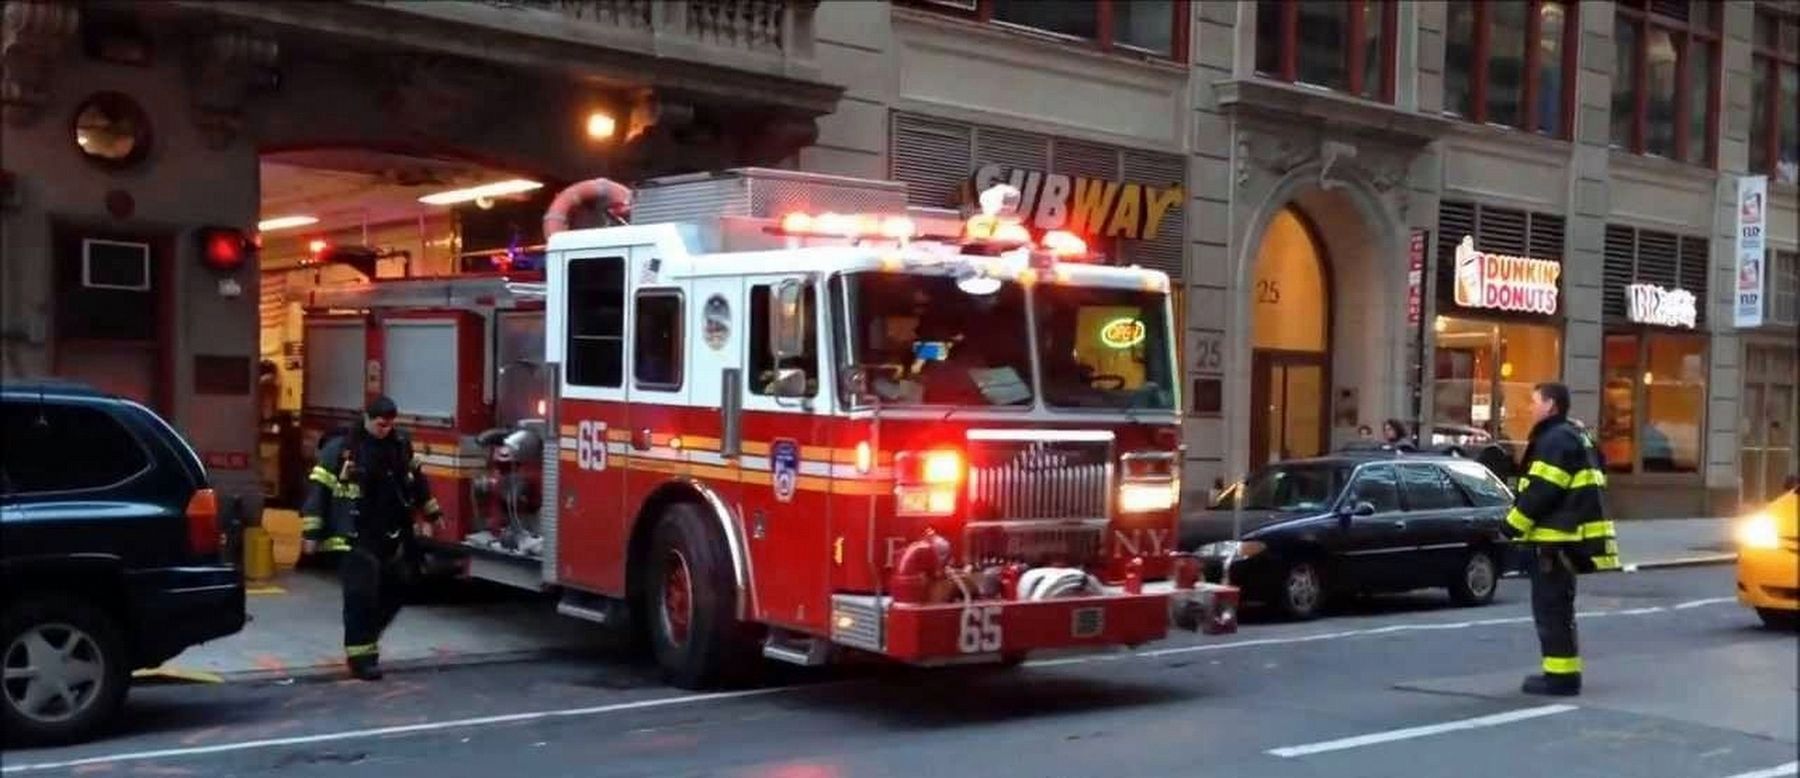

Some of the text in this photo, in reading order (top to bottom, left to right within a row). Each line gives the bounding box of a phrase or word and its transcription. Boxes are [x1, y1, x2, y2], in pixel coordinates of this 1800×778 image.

[974, 164, 1183, 240] SUBWAY
[1257, 279, 1280, 305] 25
[1486, 283, 1555, 313] DONUTS
[1196, 339, 1222, 368] 25
[577, 419, 608, 471] 65
[959, 604, 1002, 652] 65
